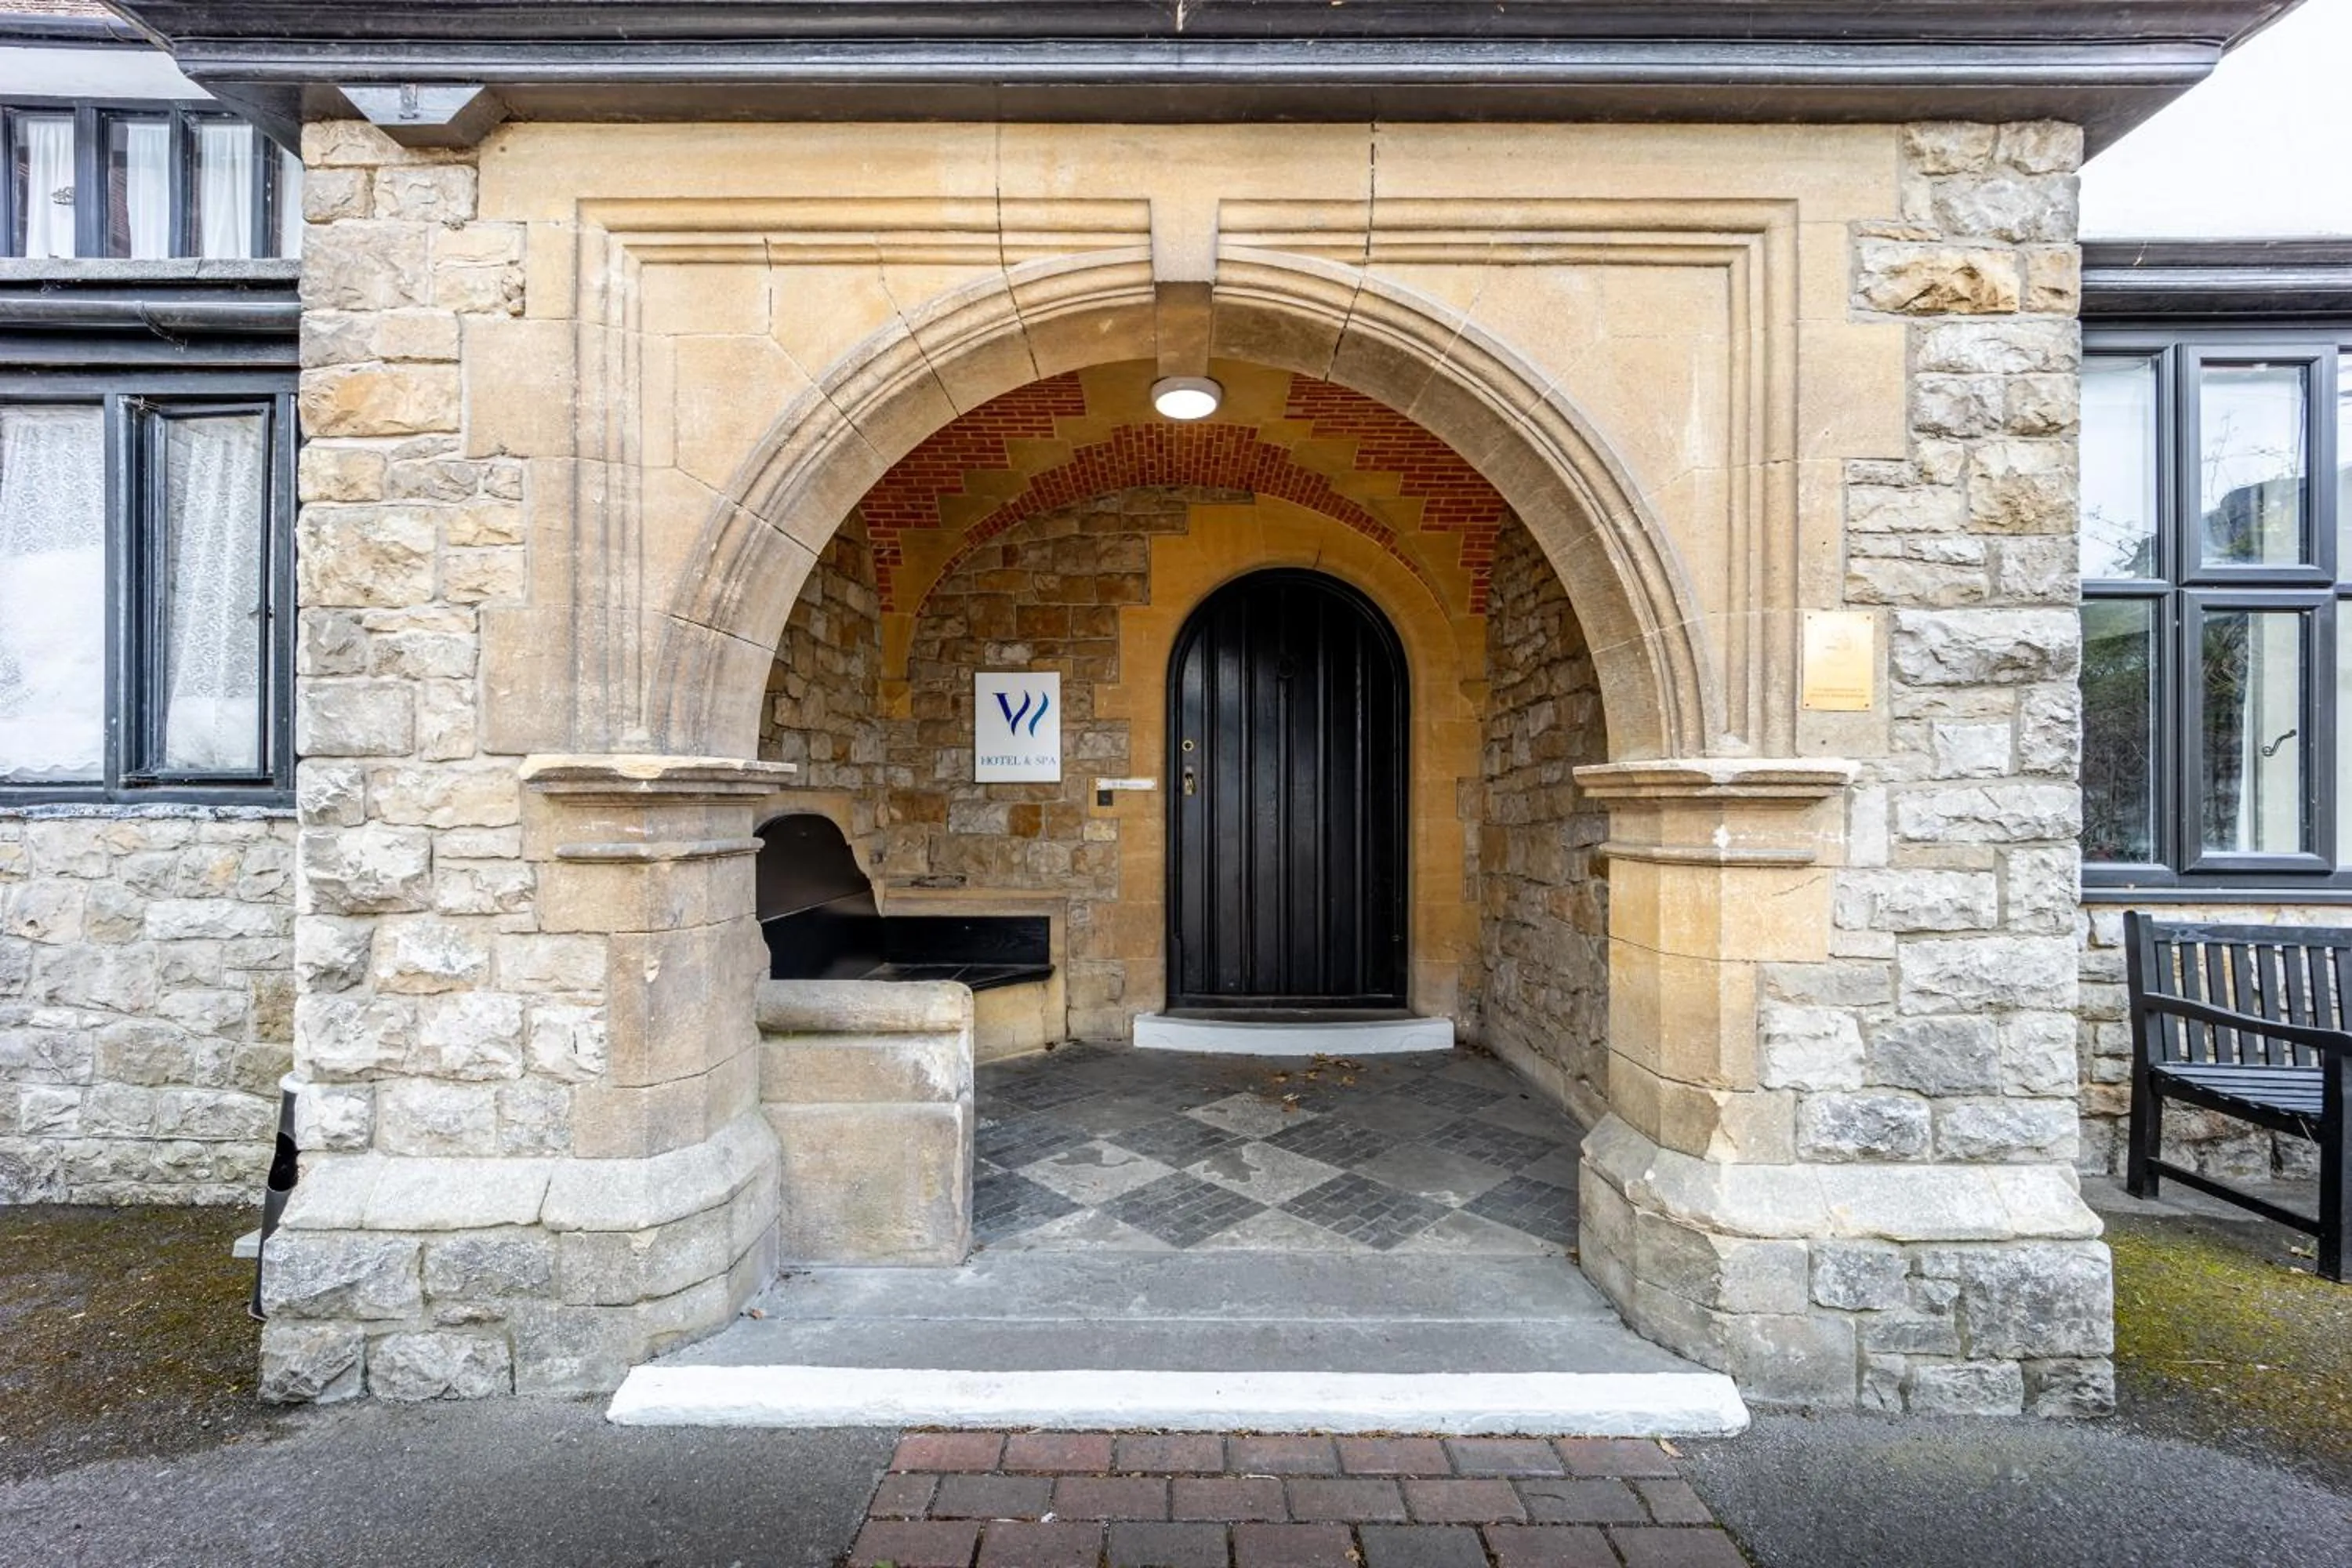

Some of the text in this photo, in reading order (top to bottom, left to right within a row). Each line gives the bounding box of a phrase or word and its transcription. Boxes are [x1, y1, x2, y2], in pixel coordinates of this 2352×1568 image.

[981, 756, 1056, 765] HOTEL & SPA
